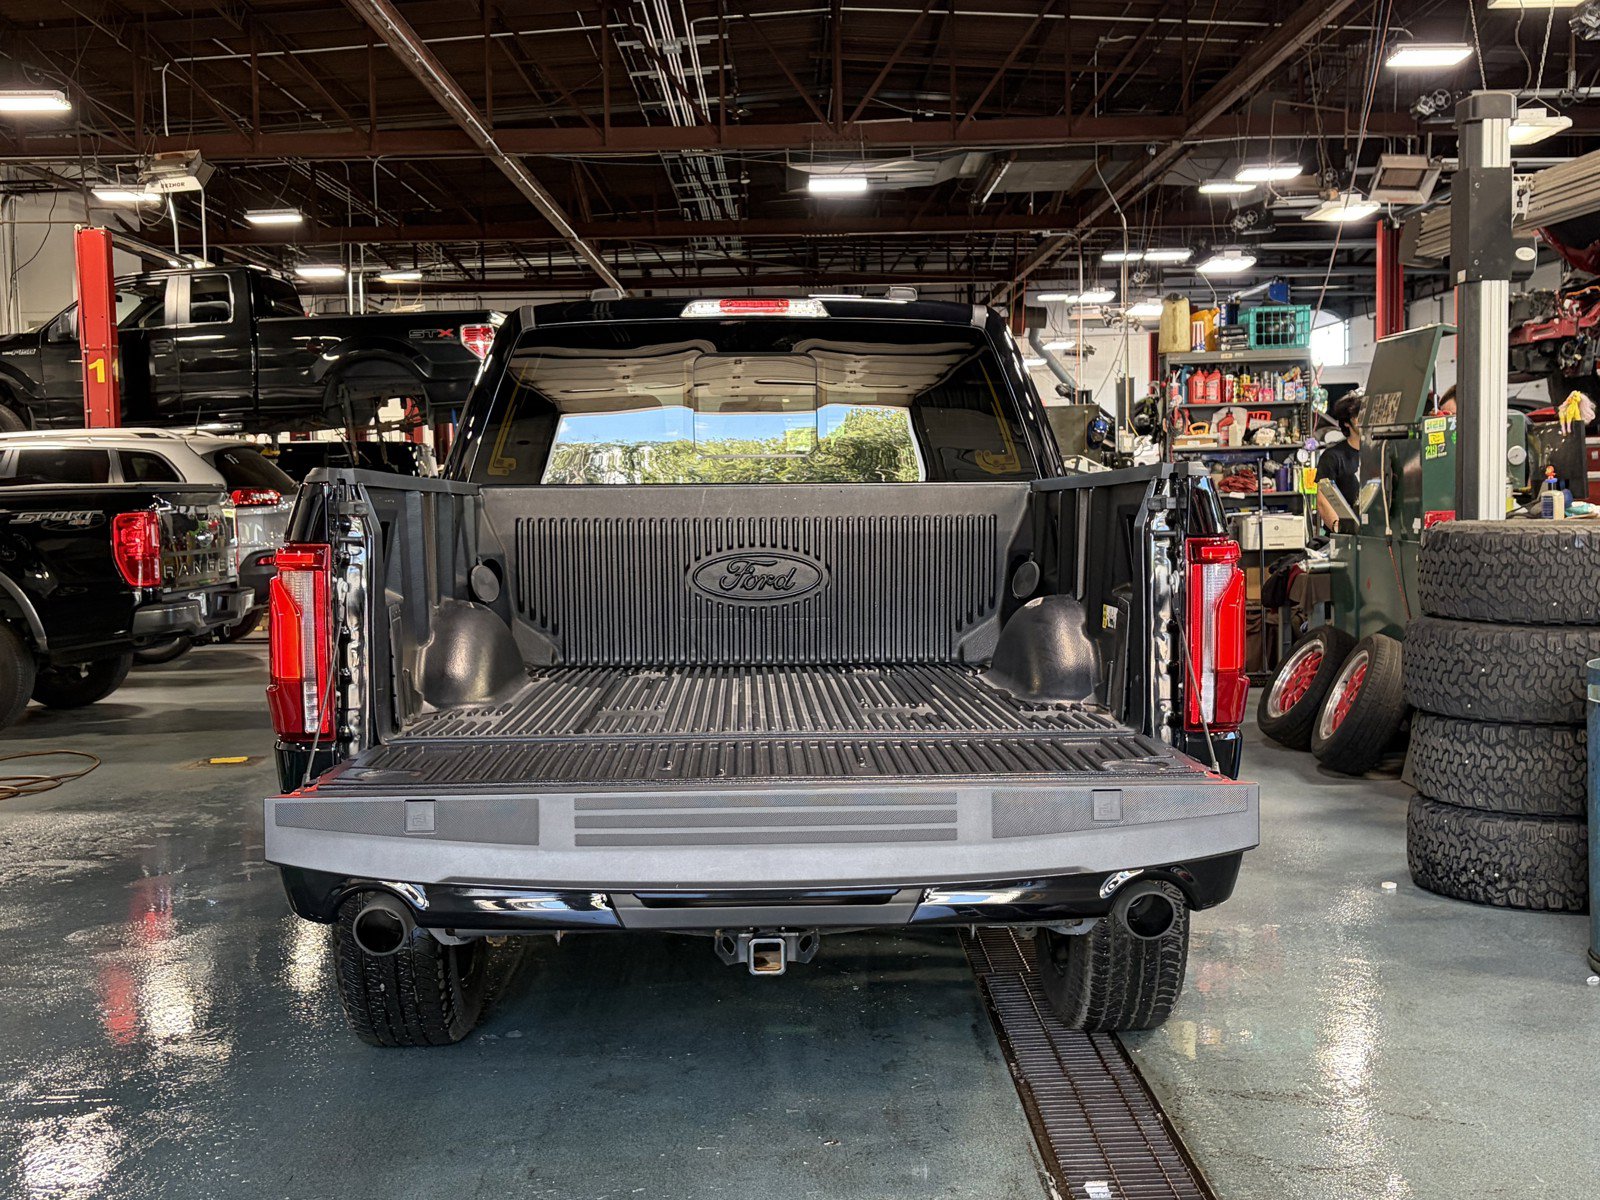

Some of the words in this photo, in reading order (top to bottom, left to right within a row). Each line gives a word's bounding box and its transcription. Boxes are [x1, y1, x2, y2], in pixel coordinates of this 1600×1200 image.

[409, 329, 454, 339] STX
[88, 358, 105, 383] 1
[9, 510, 104, 524] SPORT
[719, 559, 798, 591] Ford
